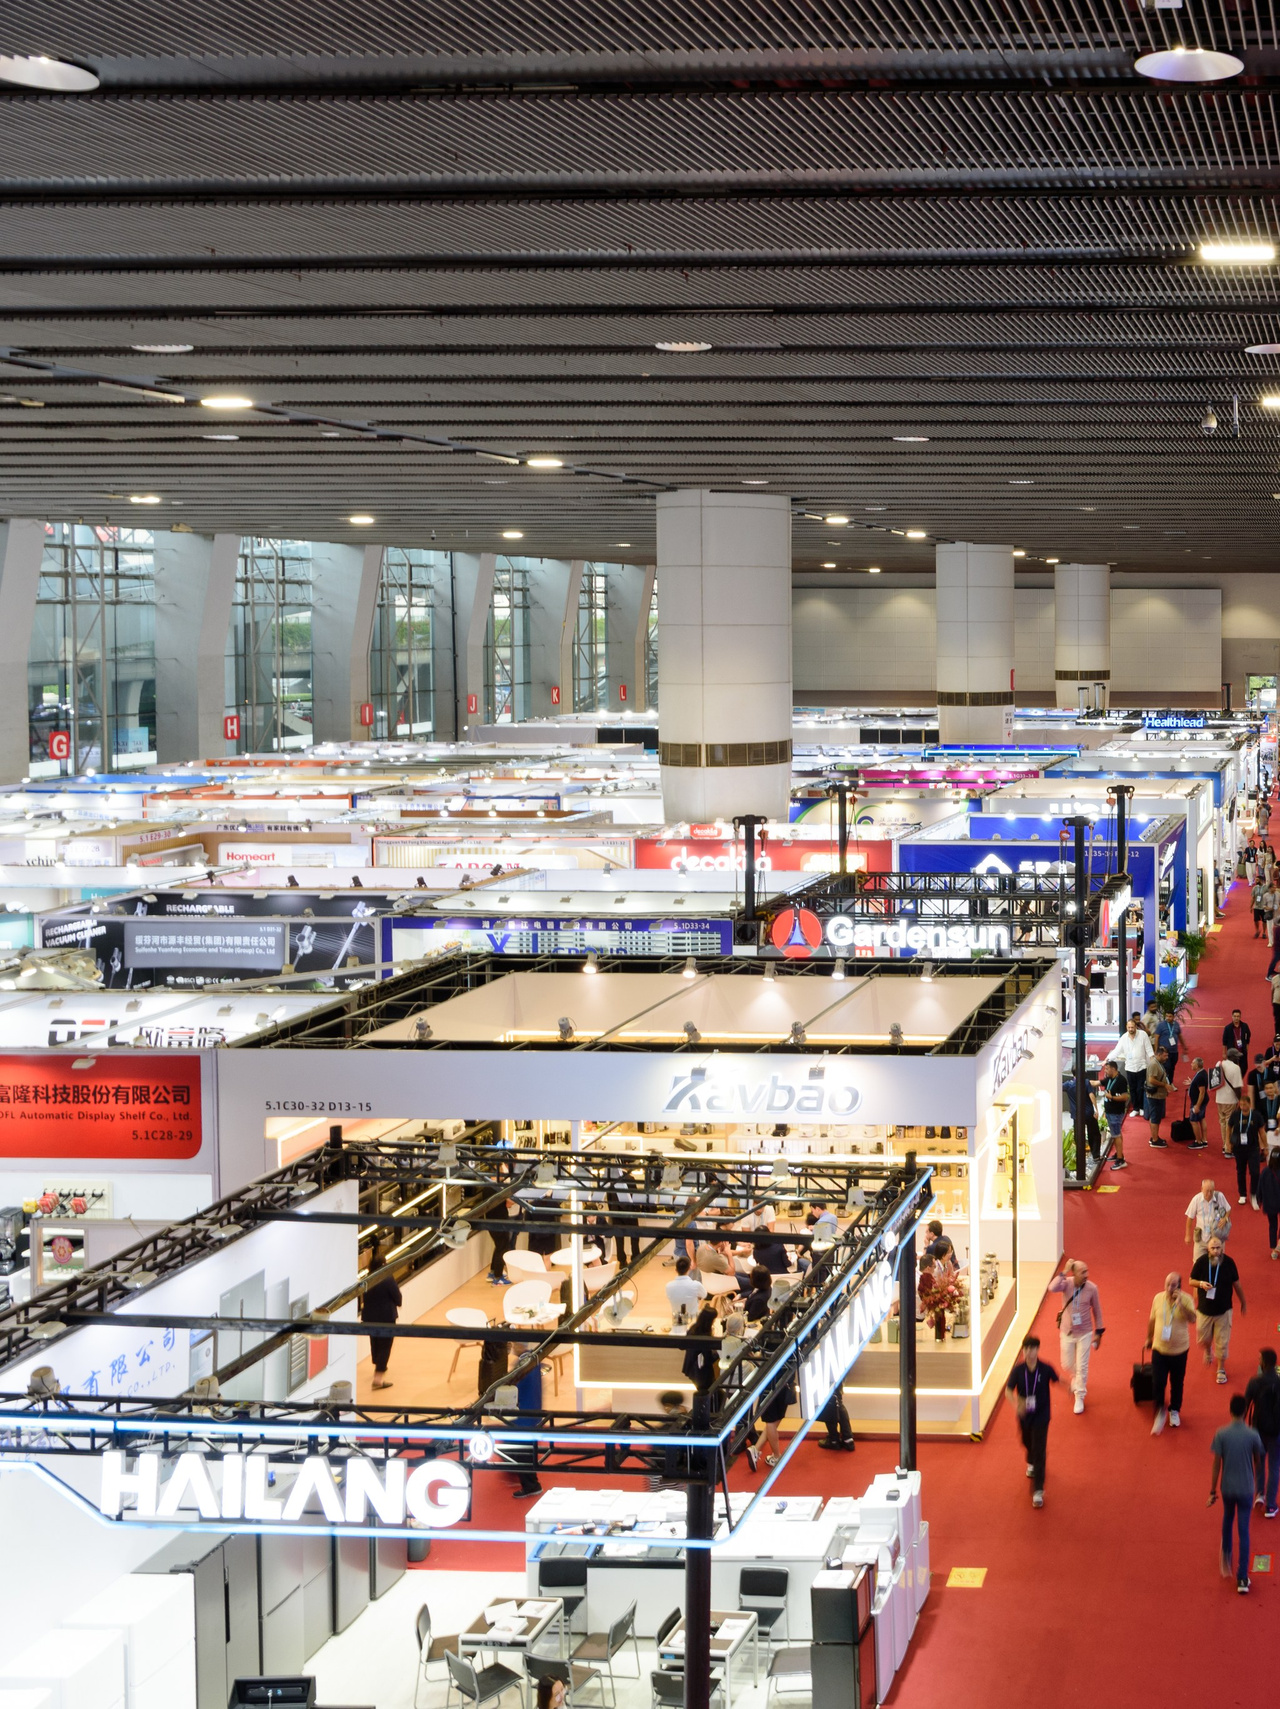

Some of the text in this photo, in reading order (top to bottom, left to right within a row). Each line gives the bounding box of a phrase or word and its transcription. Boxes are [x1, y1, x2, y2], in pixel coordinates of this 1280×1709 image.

[552, 688, 559, 703] K
[620, 686, 626, 699] L
[469, 696, 477, 713] J
[226, 717, 238, 738] H
[1145, 717, 1204, 728] Healthlead
[52, 734, 68, 757] G
[226, 851, 276, 861] Homeart
[671, 846, 772, 871] decakia
[76, 925, 107, 941] CLEANER
[672, 922, 710, 930] 5.1D33-34
[826, 915, 1010, 950] Gardensun
[158, 947, 182, 955] Yuanfeng
[265, 1100, 372, 1113] 5.1C30-32 D13-15
[20, 1111, 74, 1120] Automatic
[77, 1111, 116, 1123] Display
[119, 1111, 147, 1121] Shelf
[172, 1112, 193, 1122] Ltd.
[131, 1130, 193, 1141] 5.1C28-29
[799, 1260, 893, 1420] HAILANG
[100, 1449, 472, 1528] HAILANG
